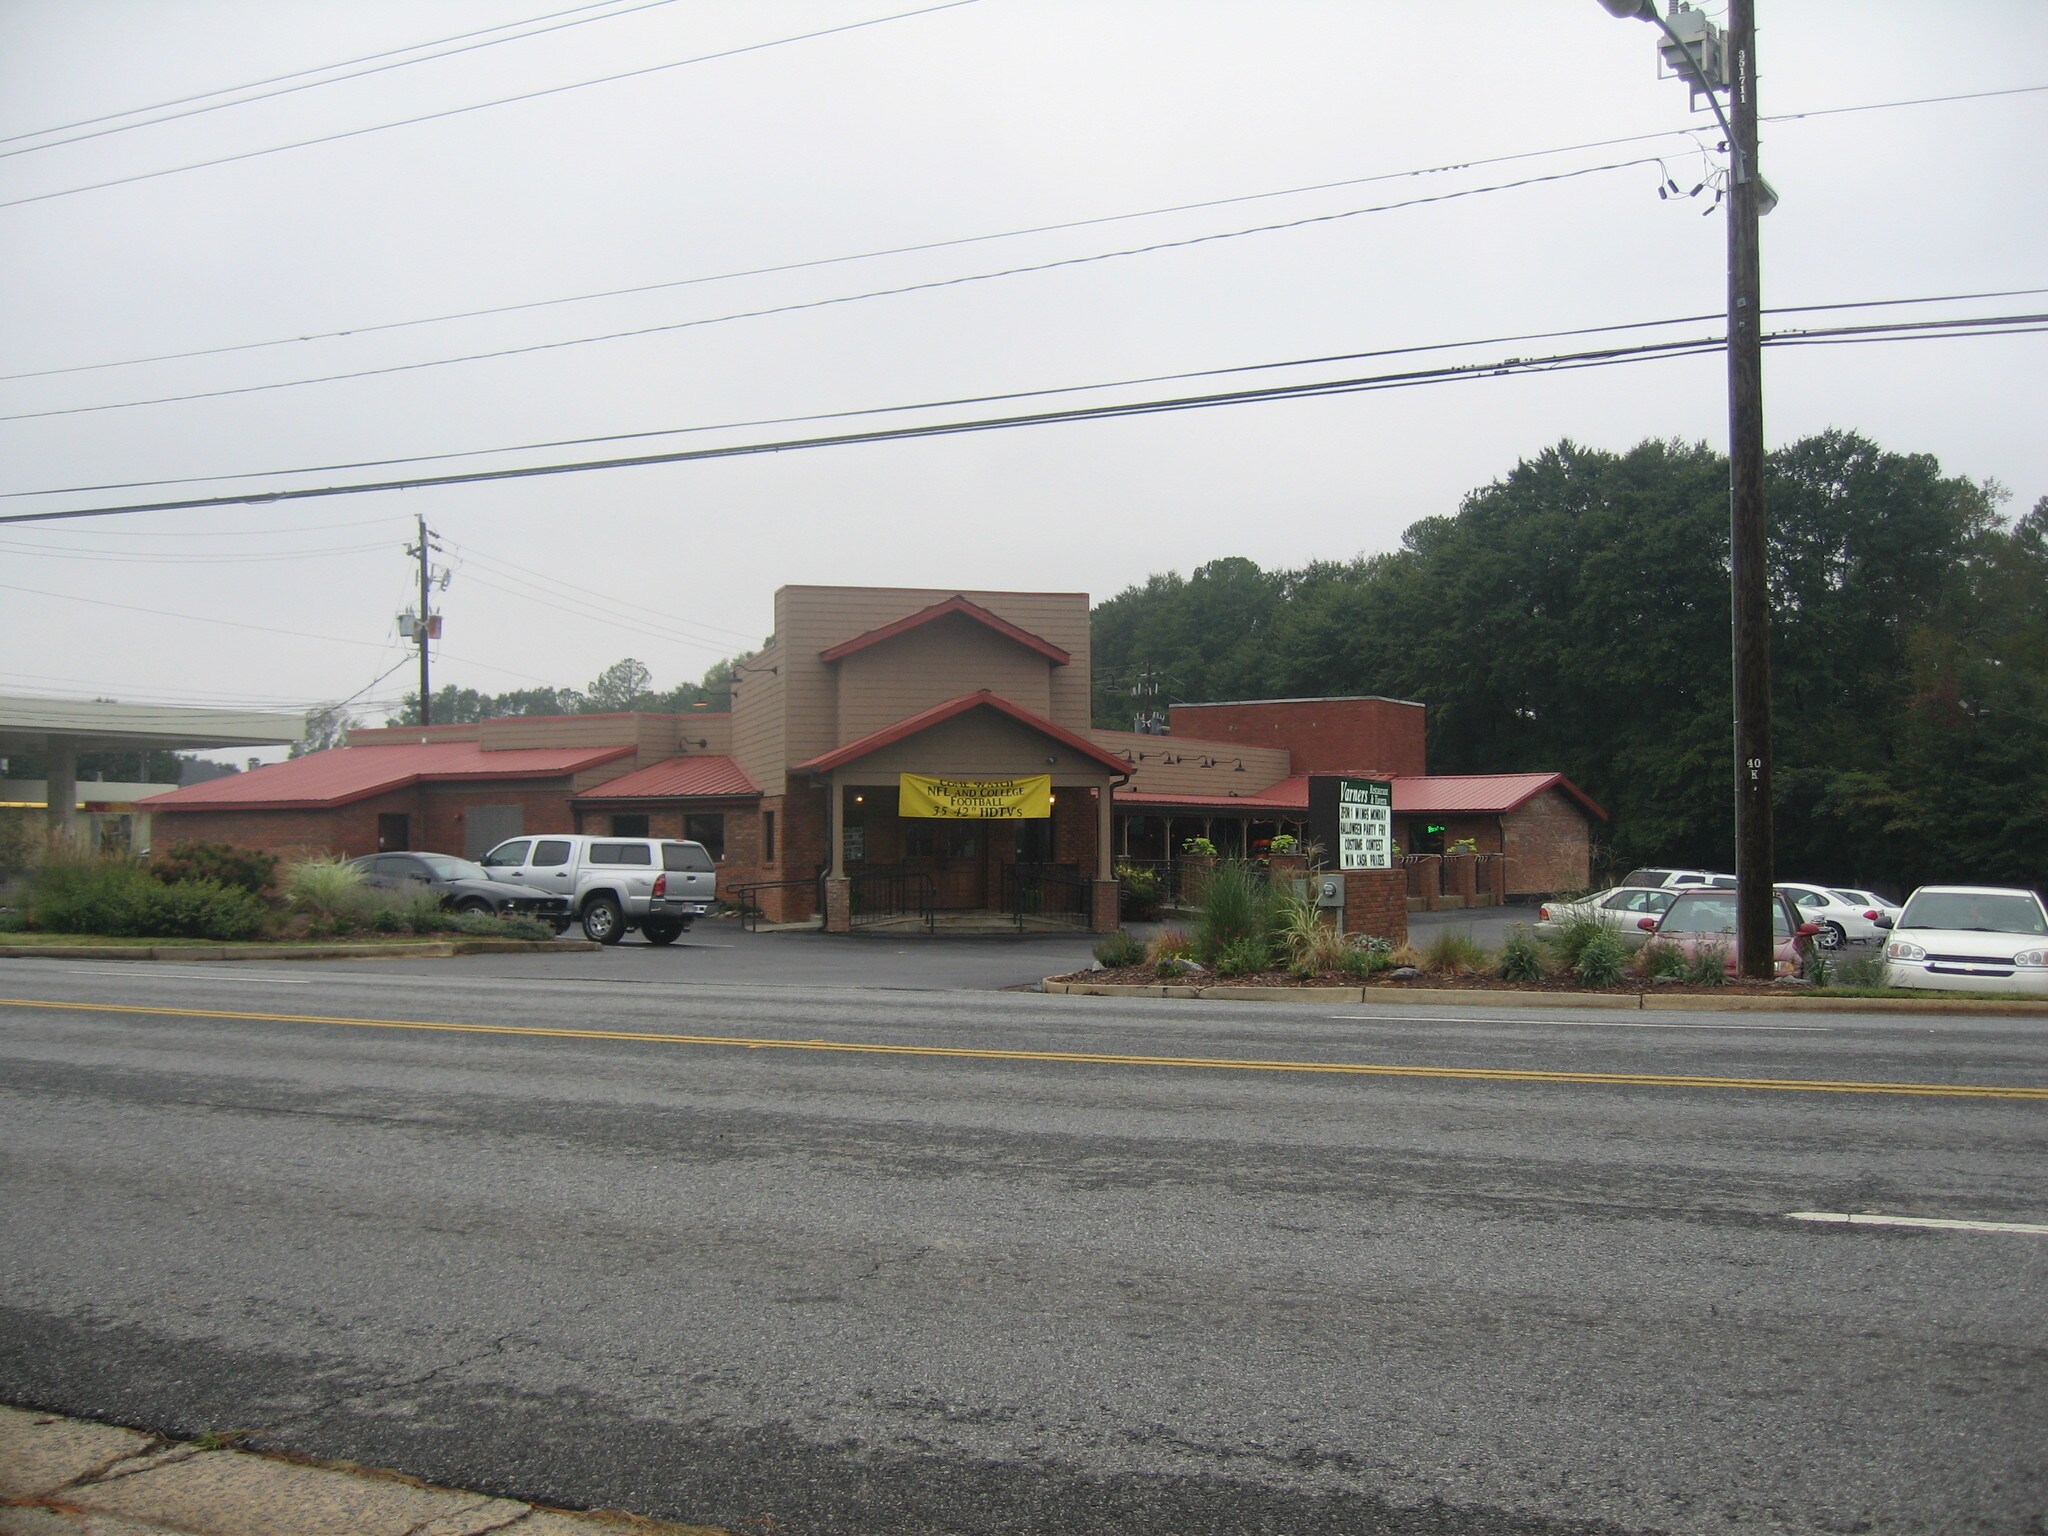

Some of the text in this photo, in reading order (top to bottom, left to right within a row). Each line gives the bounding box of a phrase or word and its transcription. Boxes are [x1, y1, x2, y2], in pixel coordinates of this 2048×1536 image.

[1738, 49, 1746, 104] 351711
[1746, 758, 1761, 768] 40
[976, 780, 1014, 788] WATCH
[927, 786, 1025, 798] NFL AND COLLEGE
[1340, 781, 1368, 803] Varners
[950, 797, 1005, 807] FOOTBALL
[1355, 807, 1369, 821] WINGS
[1370, 808, 1387, 821] MONDAY
[1363, 823, 1376, 836] PARTY
[1344, 838, 1384, 851] COSTUME CONTEST
[1345, 853, 1385, 867] WIN CASH PRIZES
